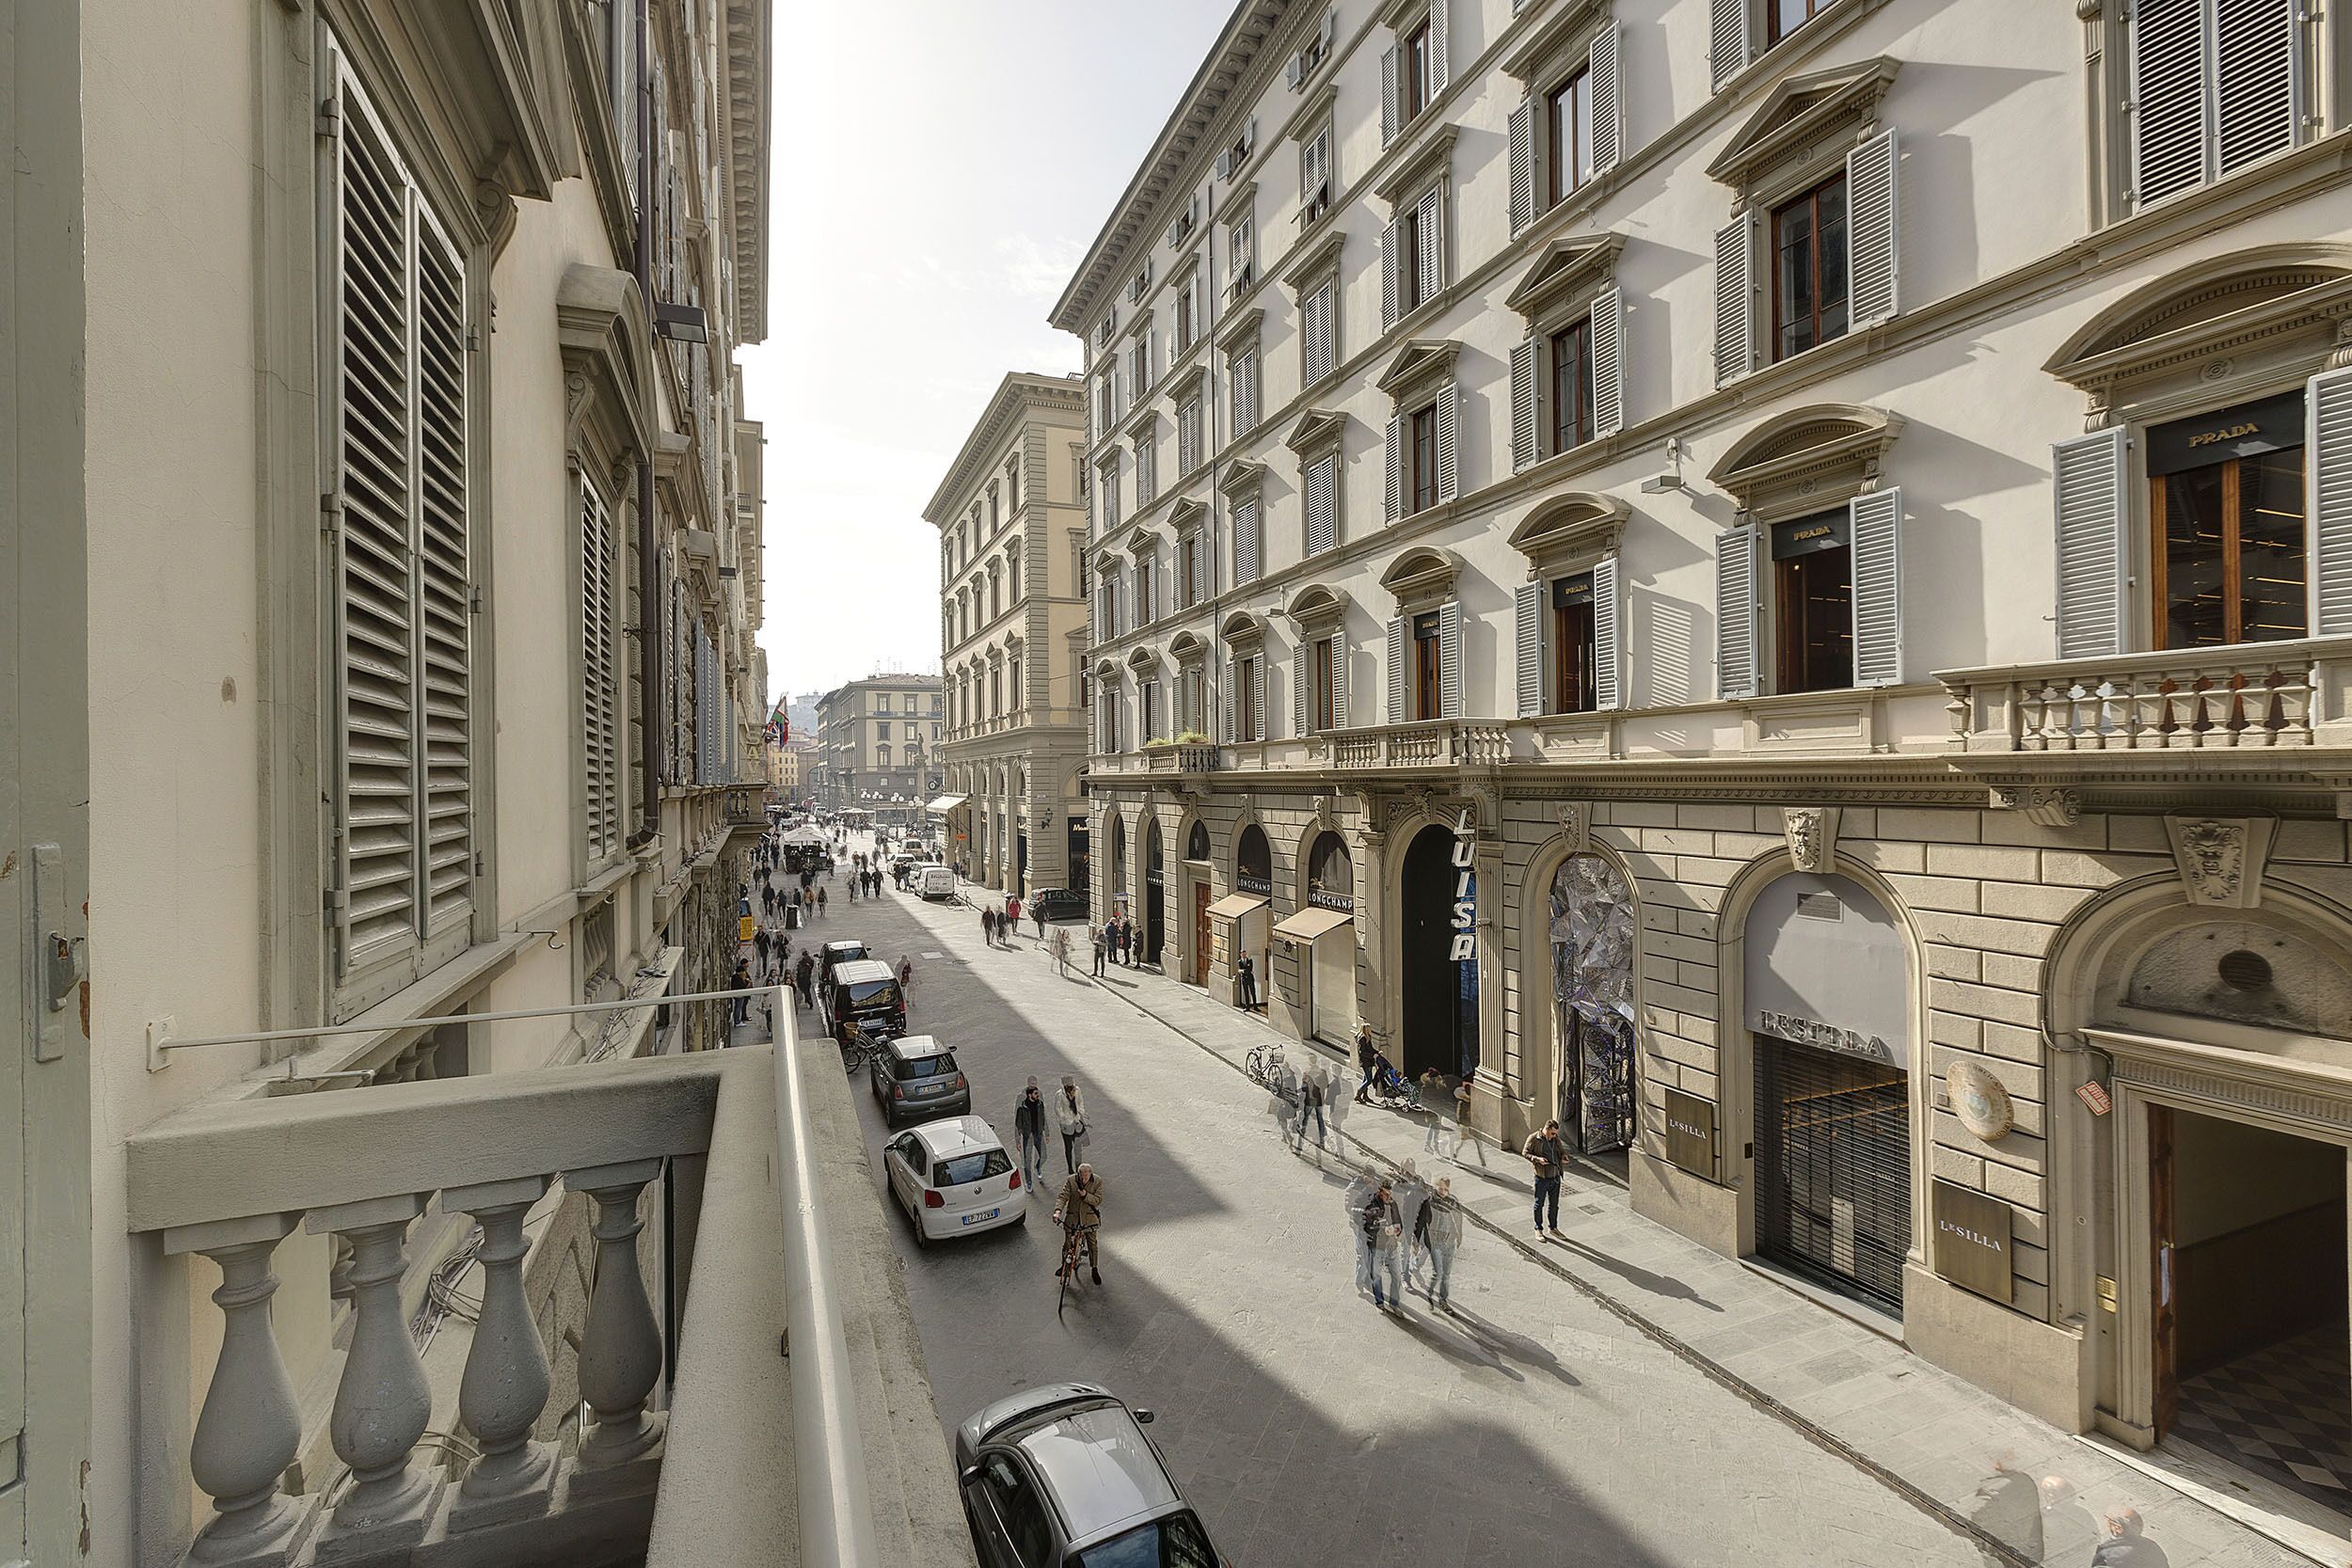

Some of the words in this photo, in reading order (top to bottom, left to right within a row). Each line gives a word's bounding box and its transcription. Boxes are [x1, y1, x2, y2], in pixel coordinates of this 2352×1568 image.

[2188, 422, 2260, 448] PRADA
[1793, 526, 1831, 541] PRADA
[1237, 879, 1271, 892] LONGCHAMP
[1450, 809, 1476, 961] LUISA
[1308, 893, 1353, 910] LONGCHAMP
